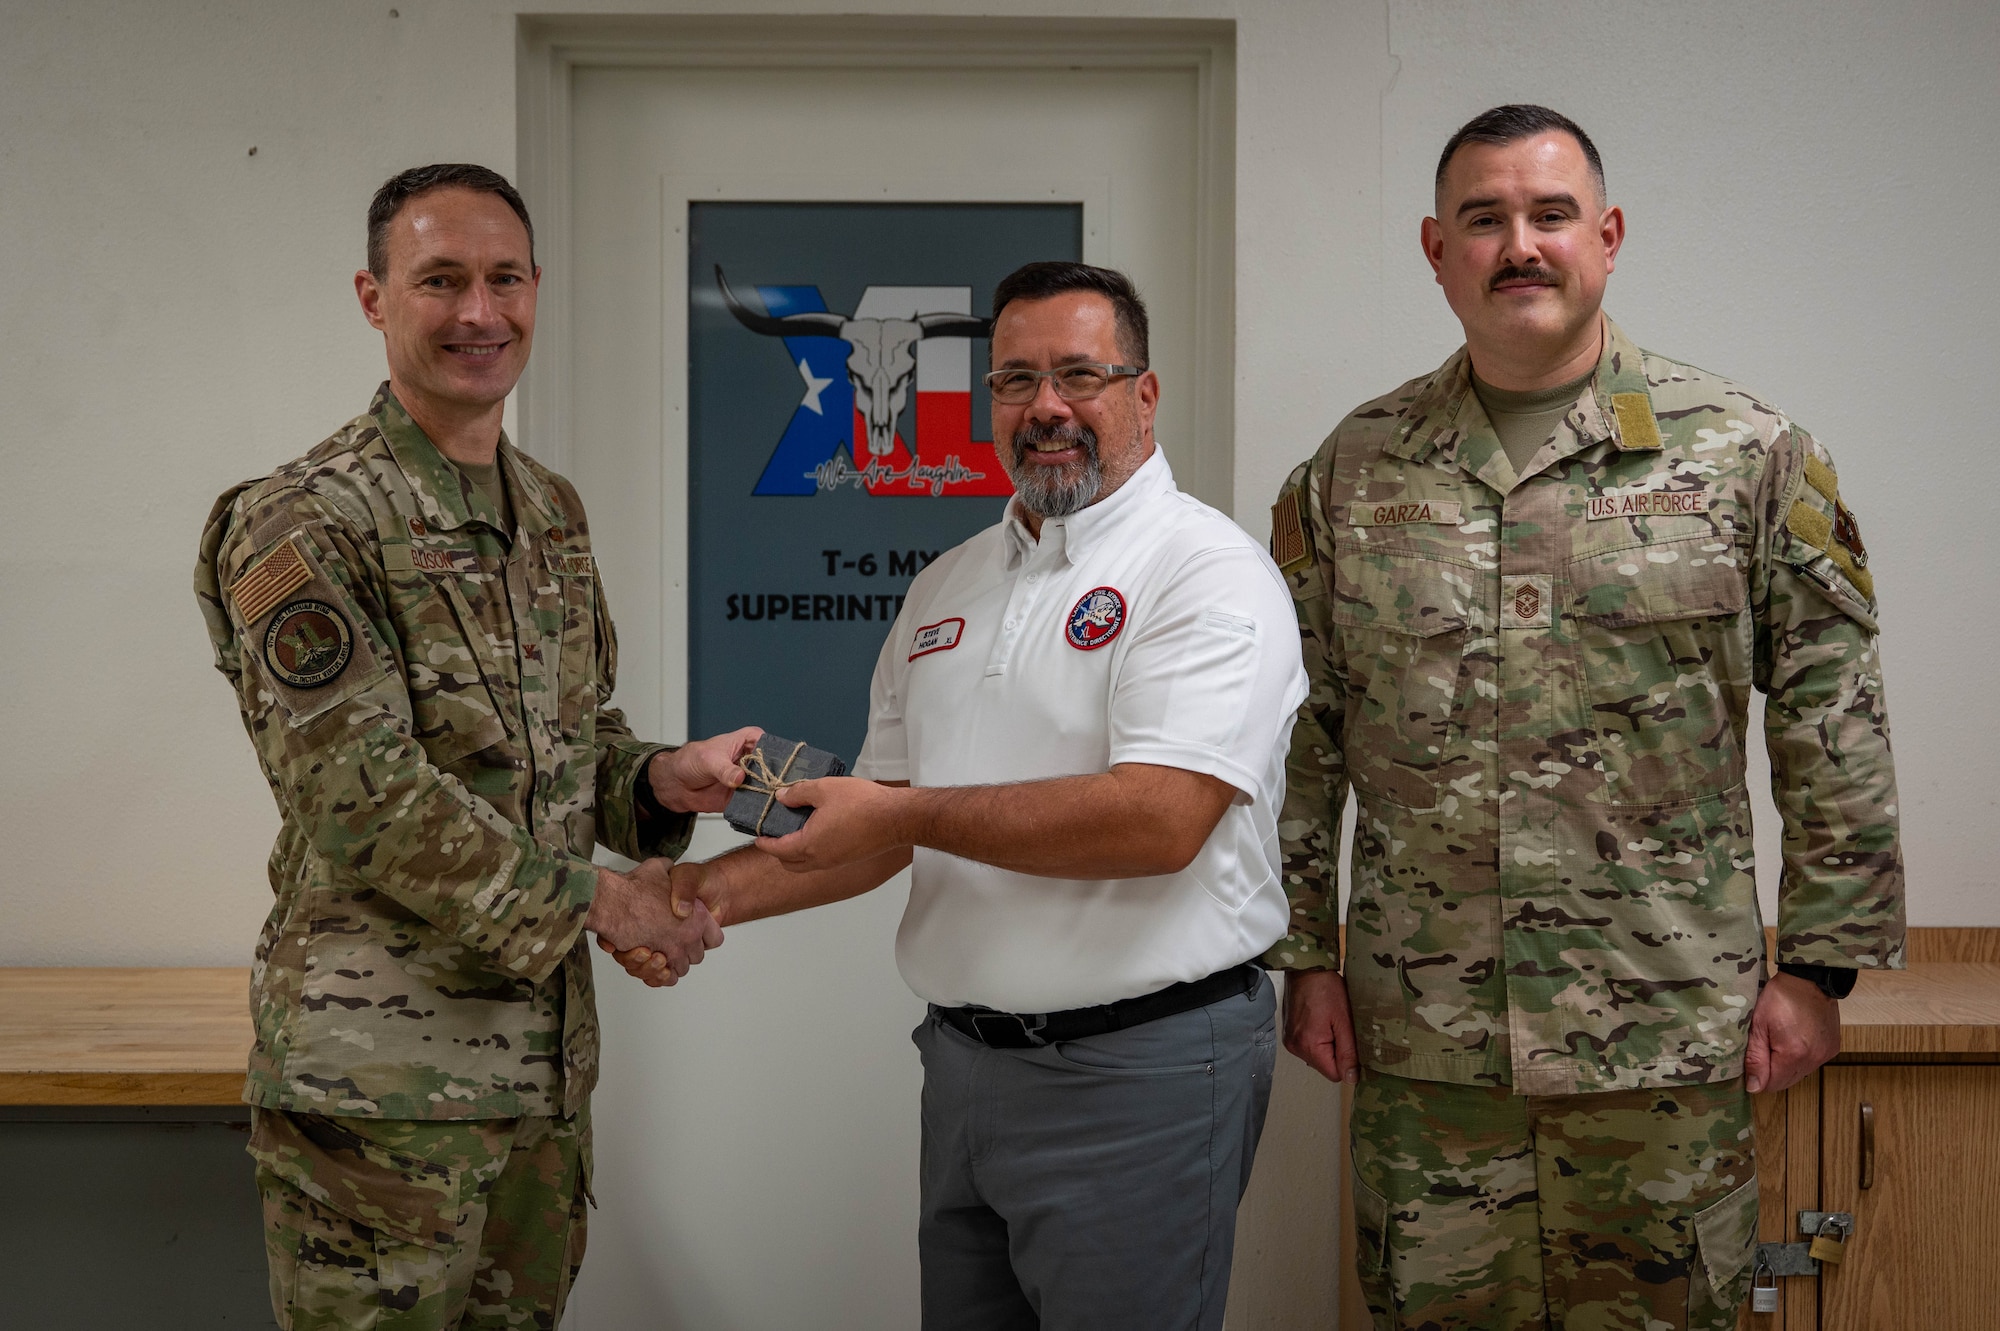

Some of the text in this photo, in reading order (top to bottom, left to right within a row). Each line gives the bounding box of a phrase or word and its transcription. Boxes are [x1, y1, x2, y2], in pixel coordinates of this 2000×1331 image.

[808, 455, 984, 496] We Are Laughlin
[1373, 503, 1431, 524] GARZA
[1592, 493, 1701, 516] U.S. AIR FORCE
[822, 550, 877, 576] T-6
[1089, 617, 1121, 646] DIRECTORATE
